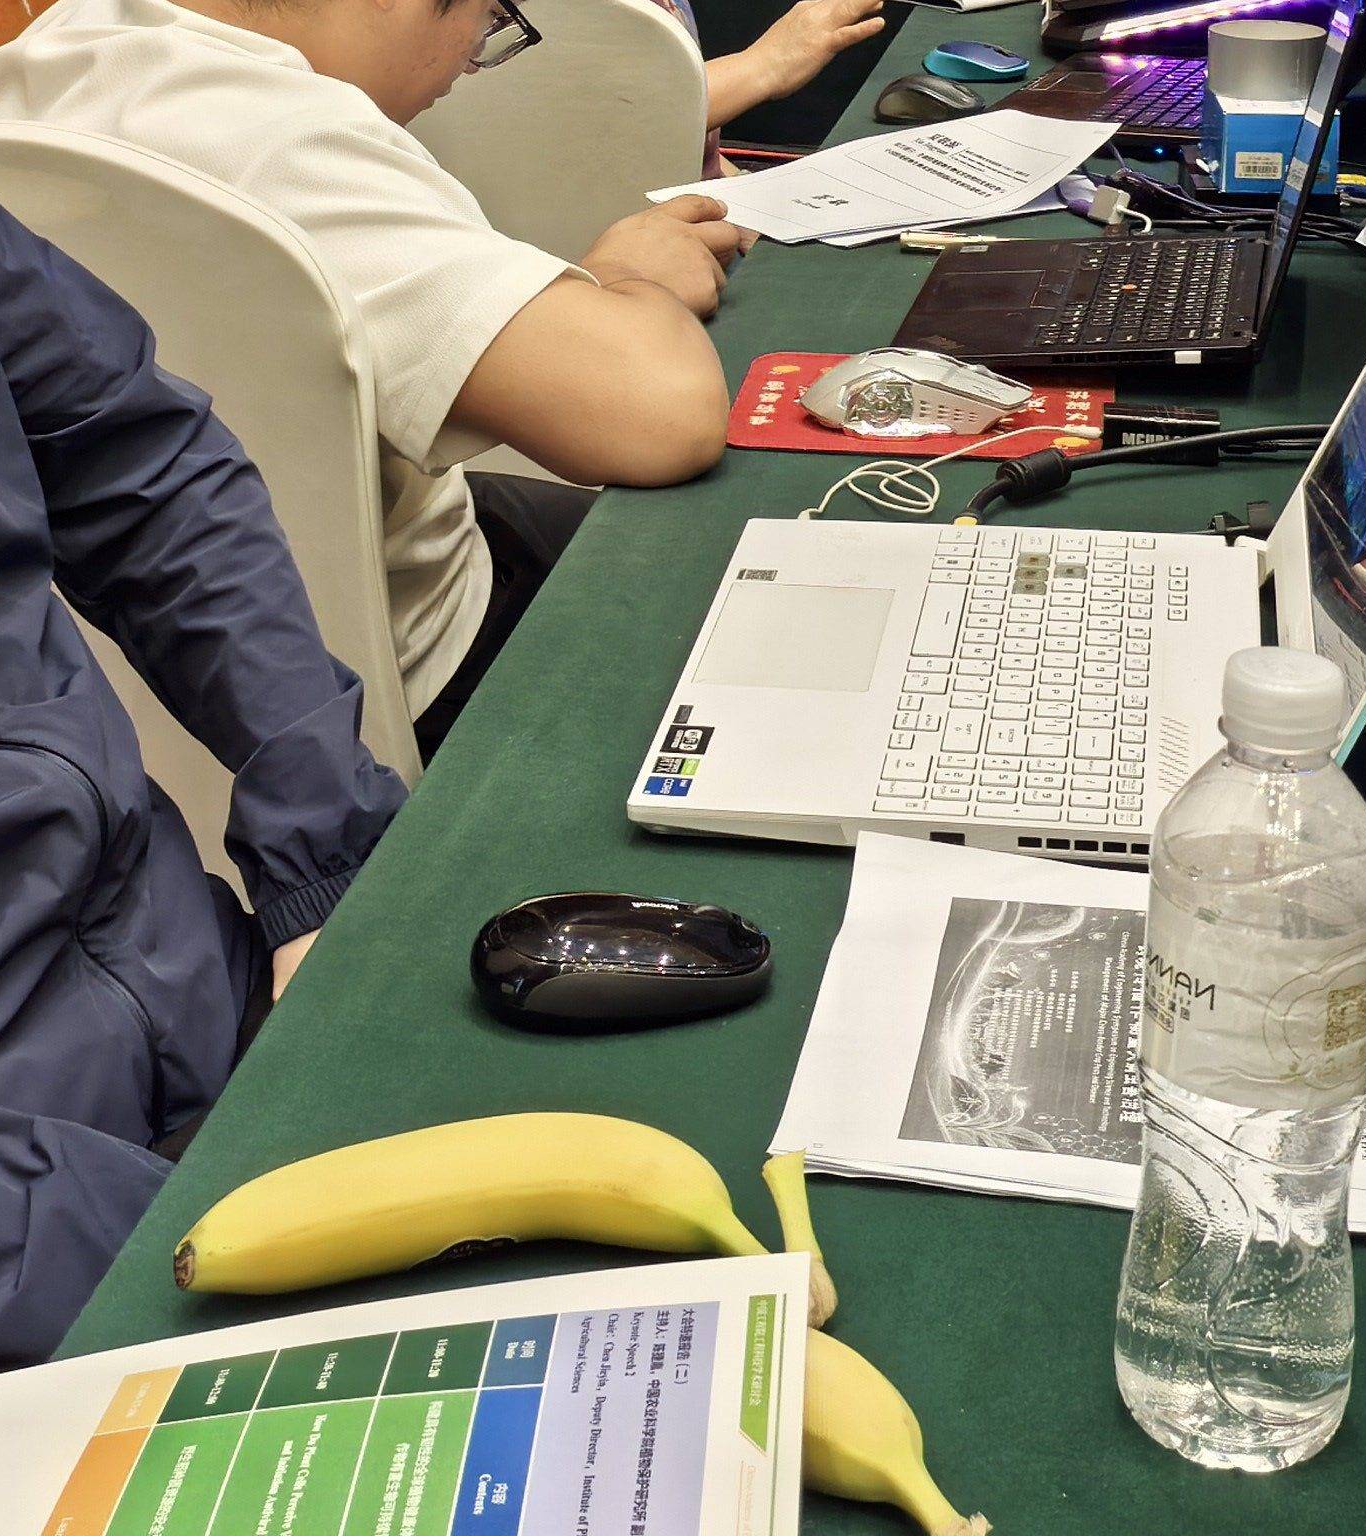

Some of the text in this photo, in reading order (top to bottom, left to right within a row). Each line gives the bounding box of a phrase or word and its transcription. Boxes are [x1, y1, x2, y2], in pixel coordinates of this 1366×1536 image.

[629, 1311, 645, 1342] Keynote
[602, 1341, 616, 1362] Chen
[625, 1342, 641, 1370] Speech
[590, 1396, 607, 1425] Deputy
[473, 1473, 493, 1515] Contents
[491, 1482, 509, 1505] 内容
[579, 1474, 595, 1513] Institute
[578, 1515, 590, 1526] of
